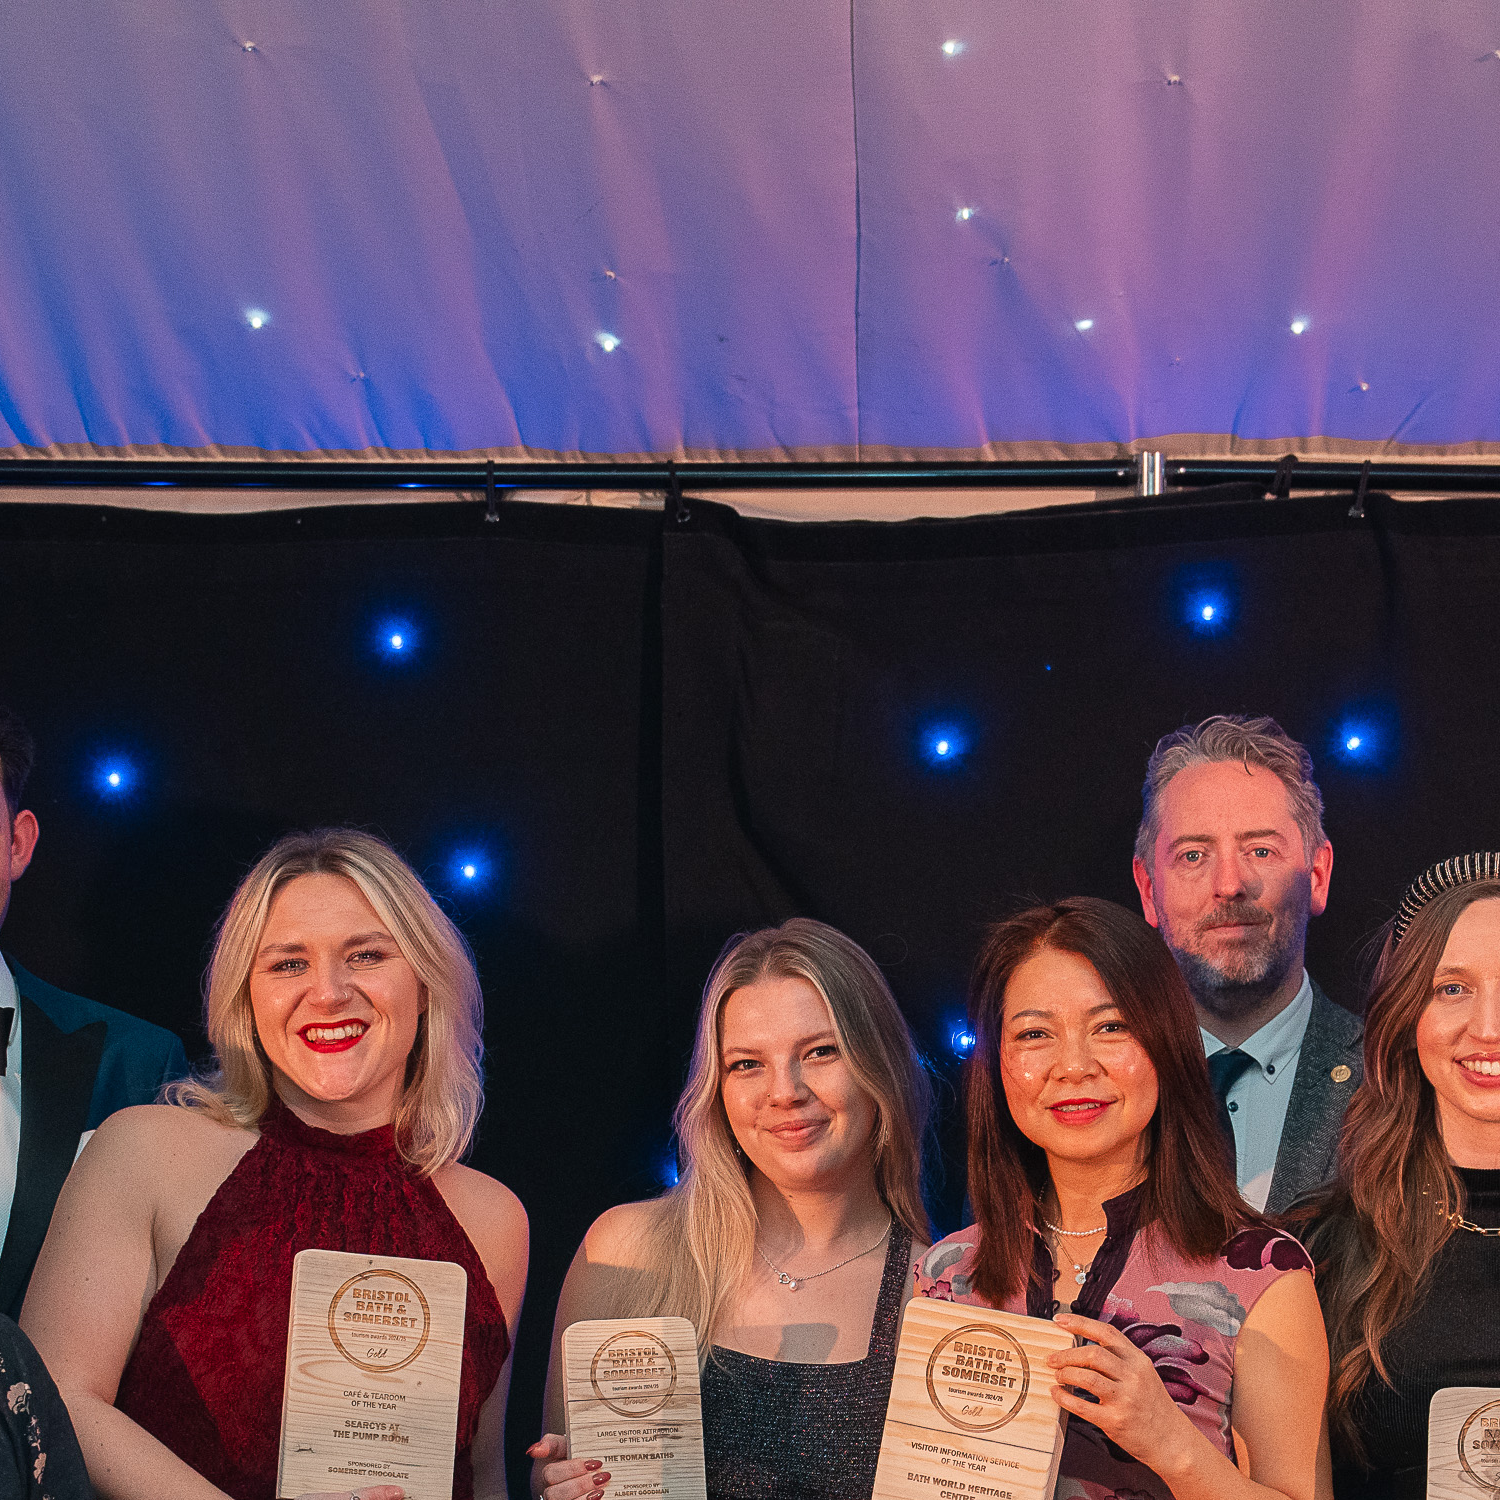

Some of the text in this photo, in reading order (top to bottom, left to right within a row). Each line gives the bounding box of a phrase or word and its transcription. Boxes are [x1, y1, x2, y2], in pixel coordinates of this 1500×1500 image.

[353, 1288, 411, 1303] BRISTOL
[356, 1301, 406, 1315] BATH &
[343, 1312, 417, 1327] SOMERSET
[367, 1348, 388, 1358] Gold
[608, 1347, 658, 1358] BRISTOL
[954, 1341, 1012, 1362] BRISTOL
[613, 1358, 655, 1368] BATH &
[956, 1355, 1006, 1374] BATH &
[604, 1368, 666, 1378] SOMERSET
[942, 1366, 1016, 1388] SOMERSET
[344, 1390, 361, 1398] CAFÉ
[371, 1393, 406, 1401] TEAROOM
[985, 1394, 1003, 1402] 2024/25
[378, 1402, 396, 1410] YEAR
[962, 1405, 983, 1417] Gold
[345, 1420, 386, 1430] SEARCYS
[333, 1430, 409, 1443] THE PUMP ROOM
[911, 1442, 1020, 1469] VISITOR INFORMATION SERVICE
[953, 1460, 966, 1468] THE
[968, 1463, 987, 1472] YEAR
[328, 1467, 409, 1479] SOMERSET CHOCOLATE
[907, 1472, 1012, 1499] BATH WORLD HERITAGE
